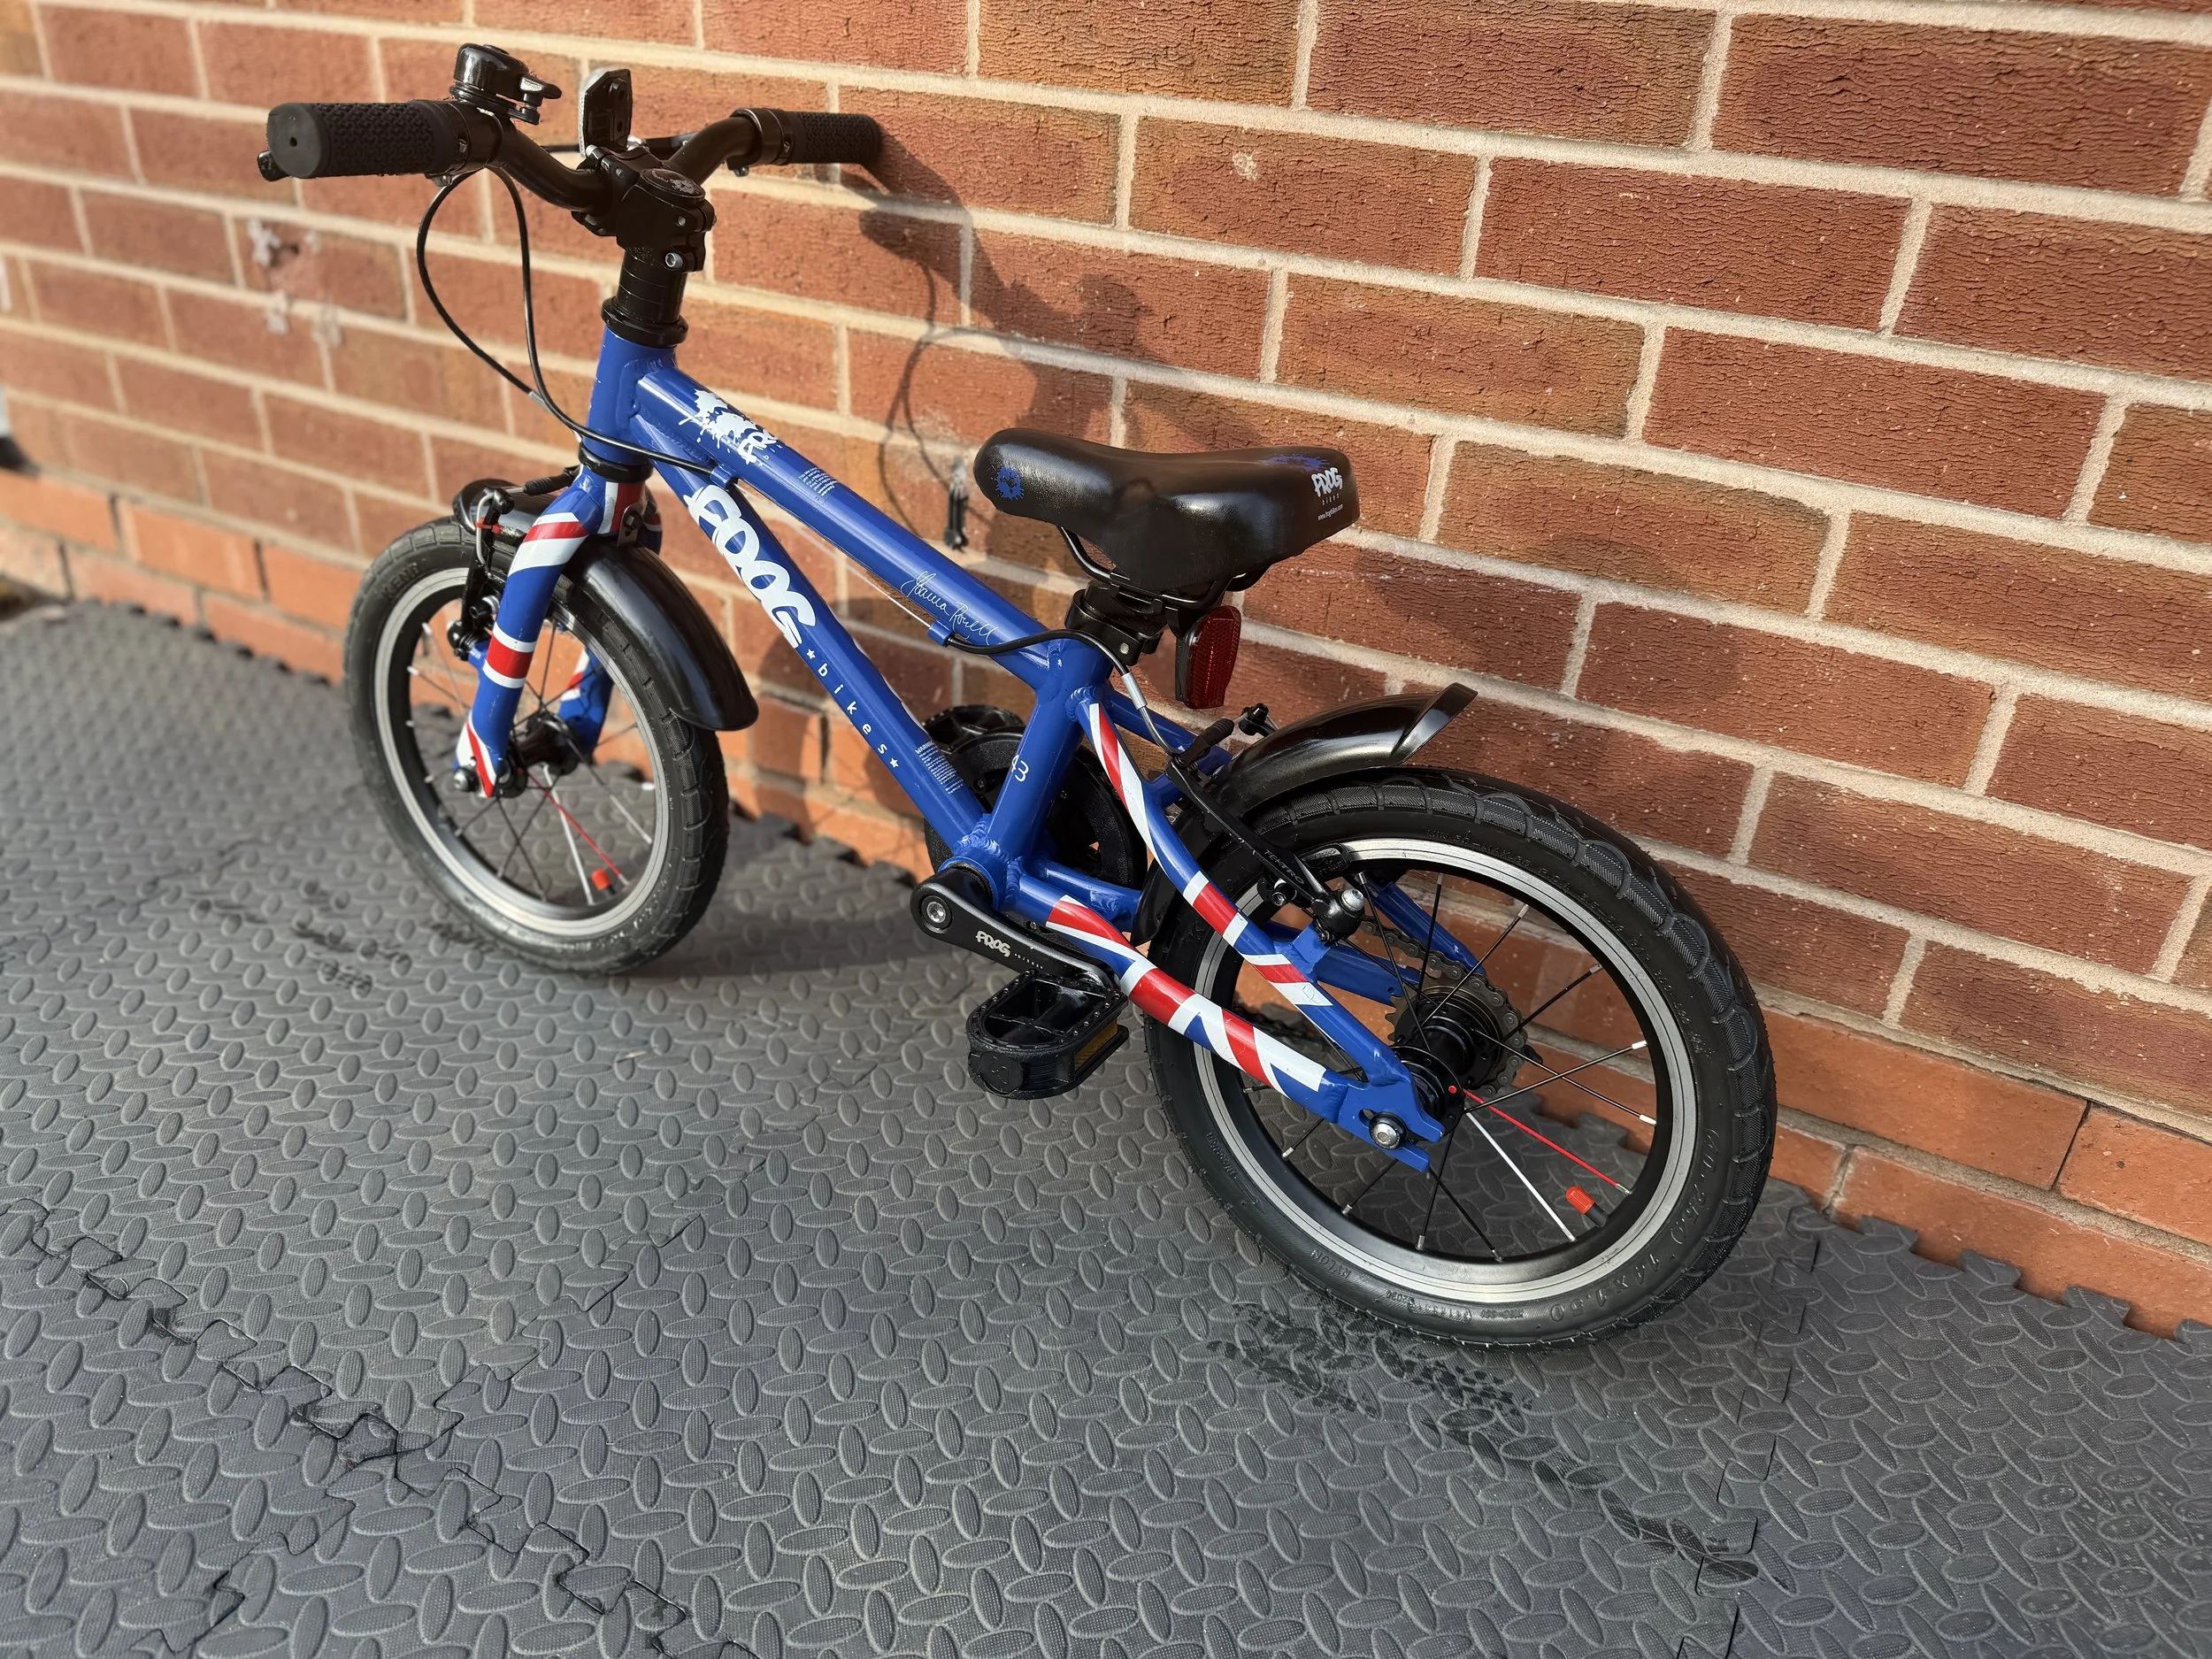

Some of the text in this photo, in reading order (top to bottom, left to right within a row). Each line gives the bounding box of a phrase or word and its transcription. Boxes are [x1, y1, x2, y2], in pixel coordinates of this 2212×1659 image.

[1311, 467, 1343, 497] FROG
[818, 663, 887, 755] bikes
[1264, 849, 1305, 885] TEKTRO
[975, 930, 1010, 957] FROG
